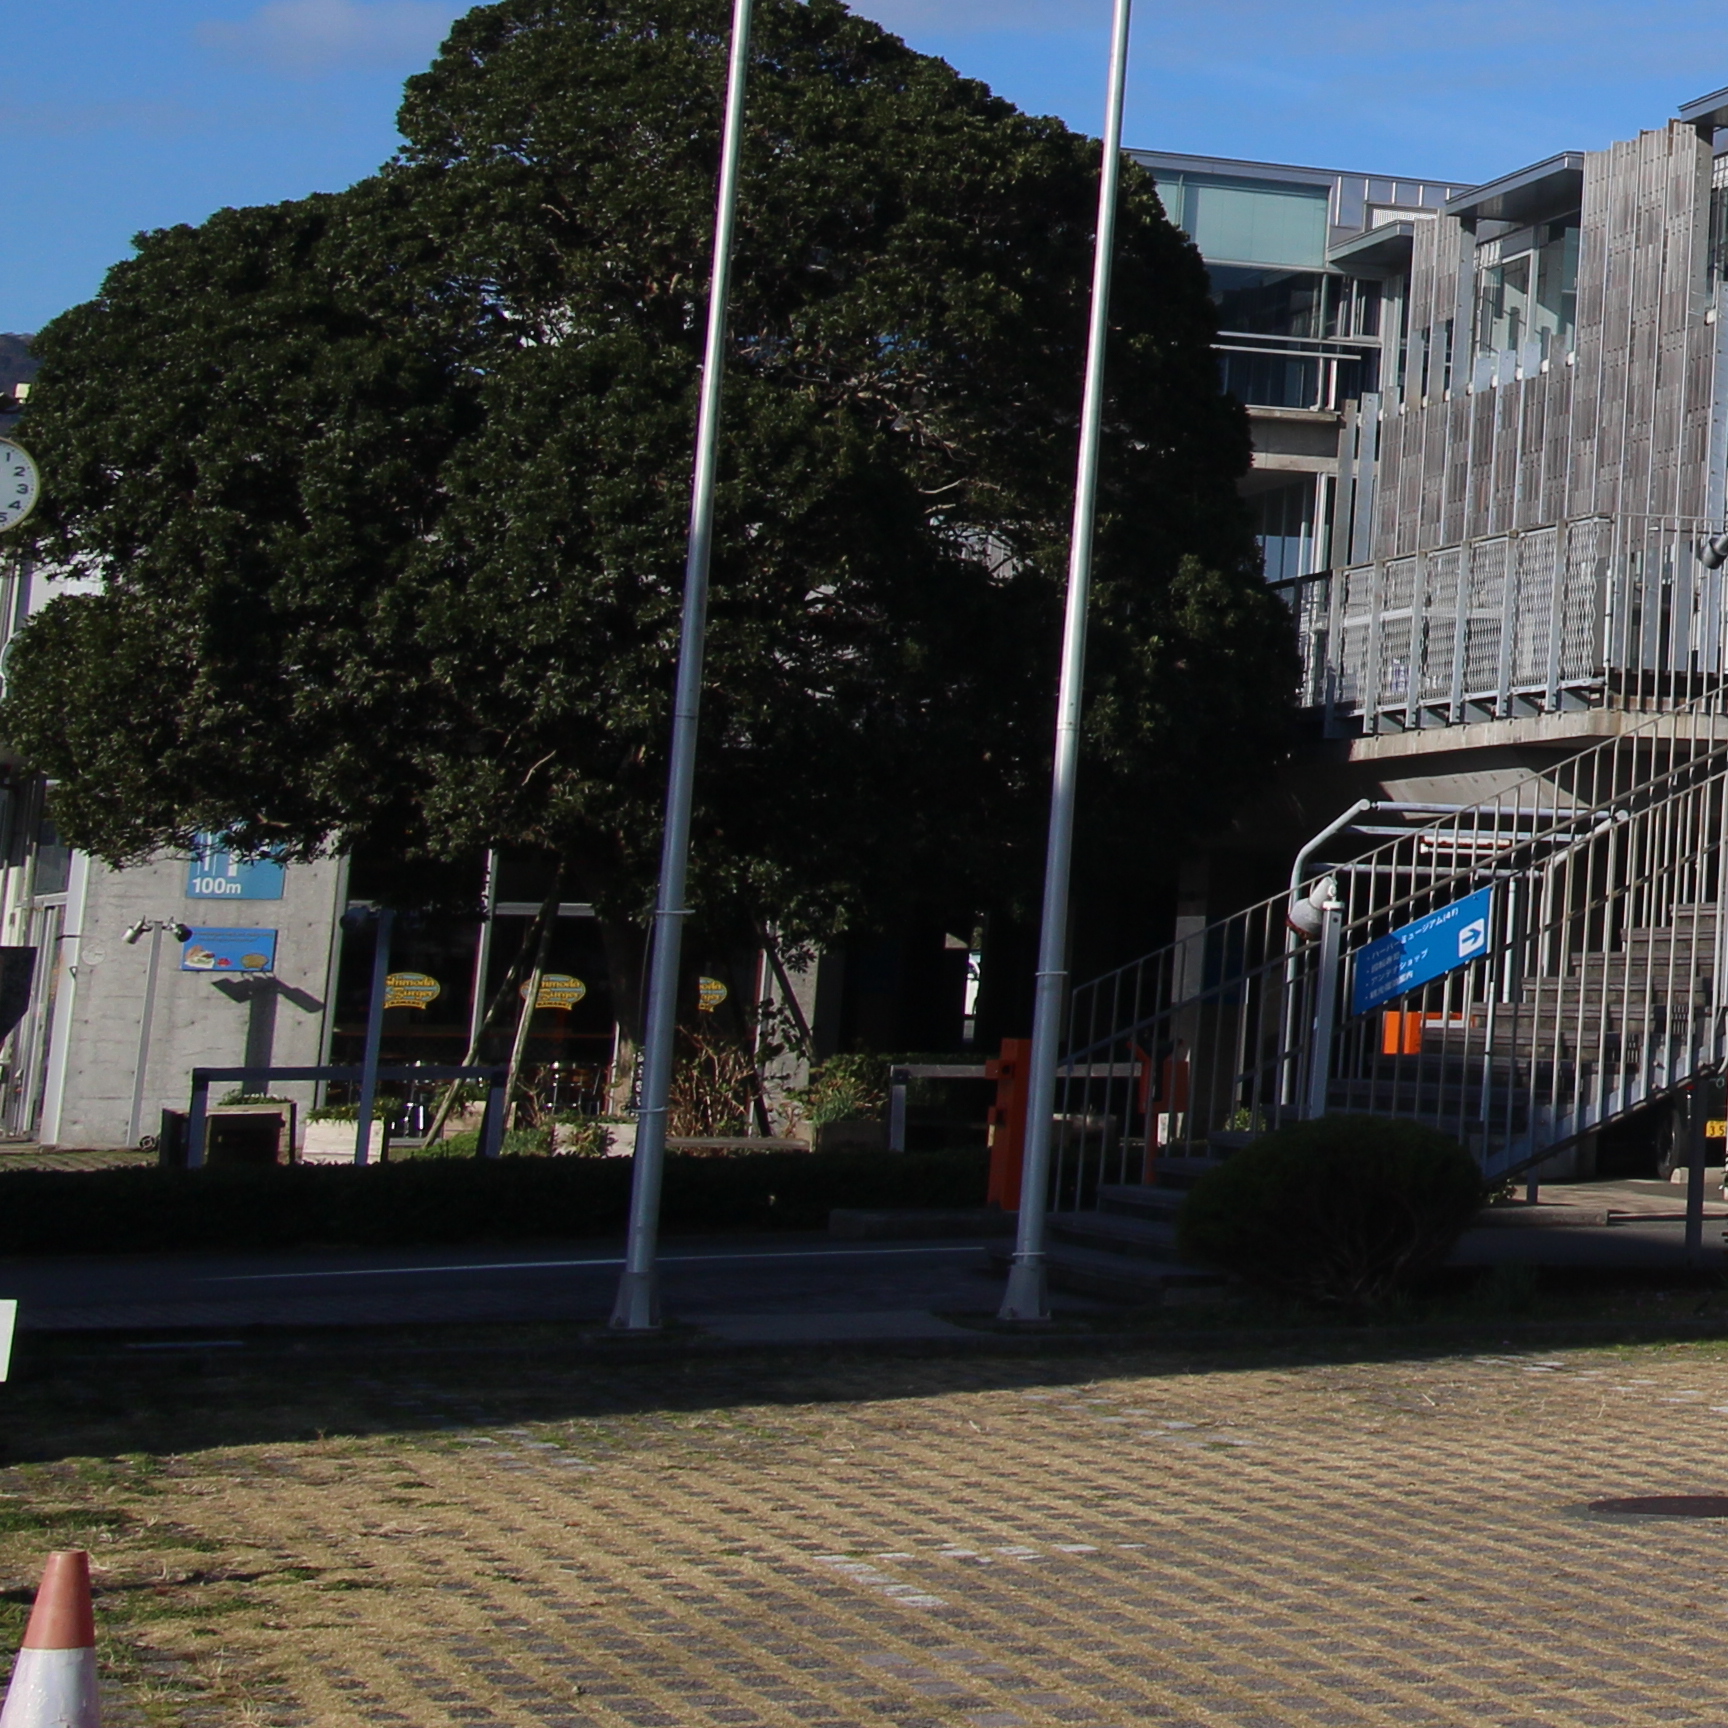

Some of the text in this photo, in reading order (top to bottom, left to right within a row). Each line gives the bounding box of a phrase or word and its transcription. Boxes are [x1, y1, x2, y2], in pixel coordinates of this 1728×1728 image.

[13, 466, 26, 477] 2
[16, 483, 29, 494] 3
[8, 500, 22, 510] 4
[192, 877, 242, 894] 100m
